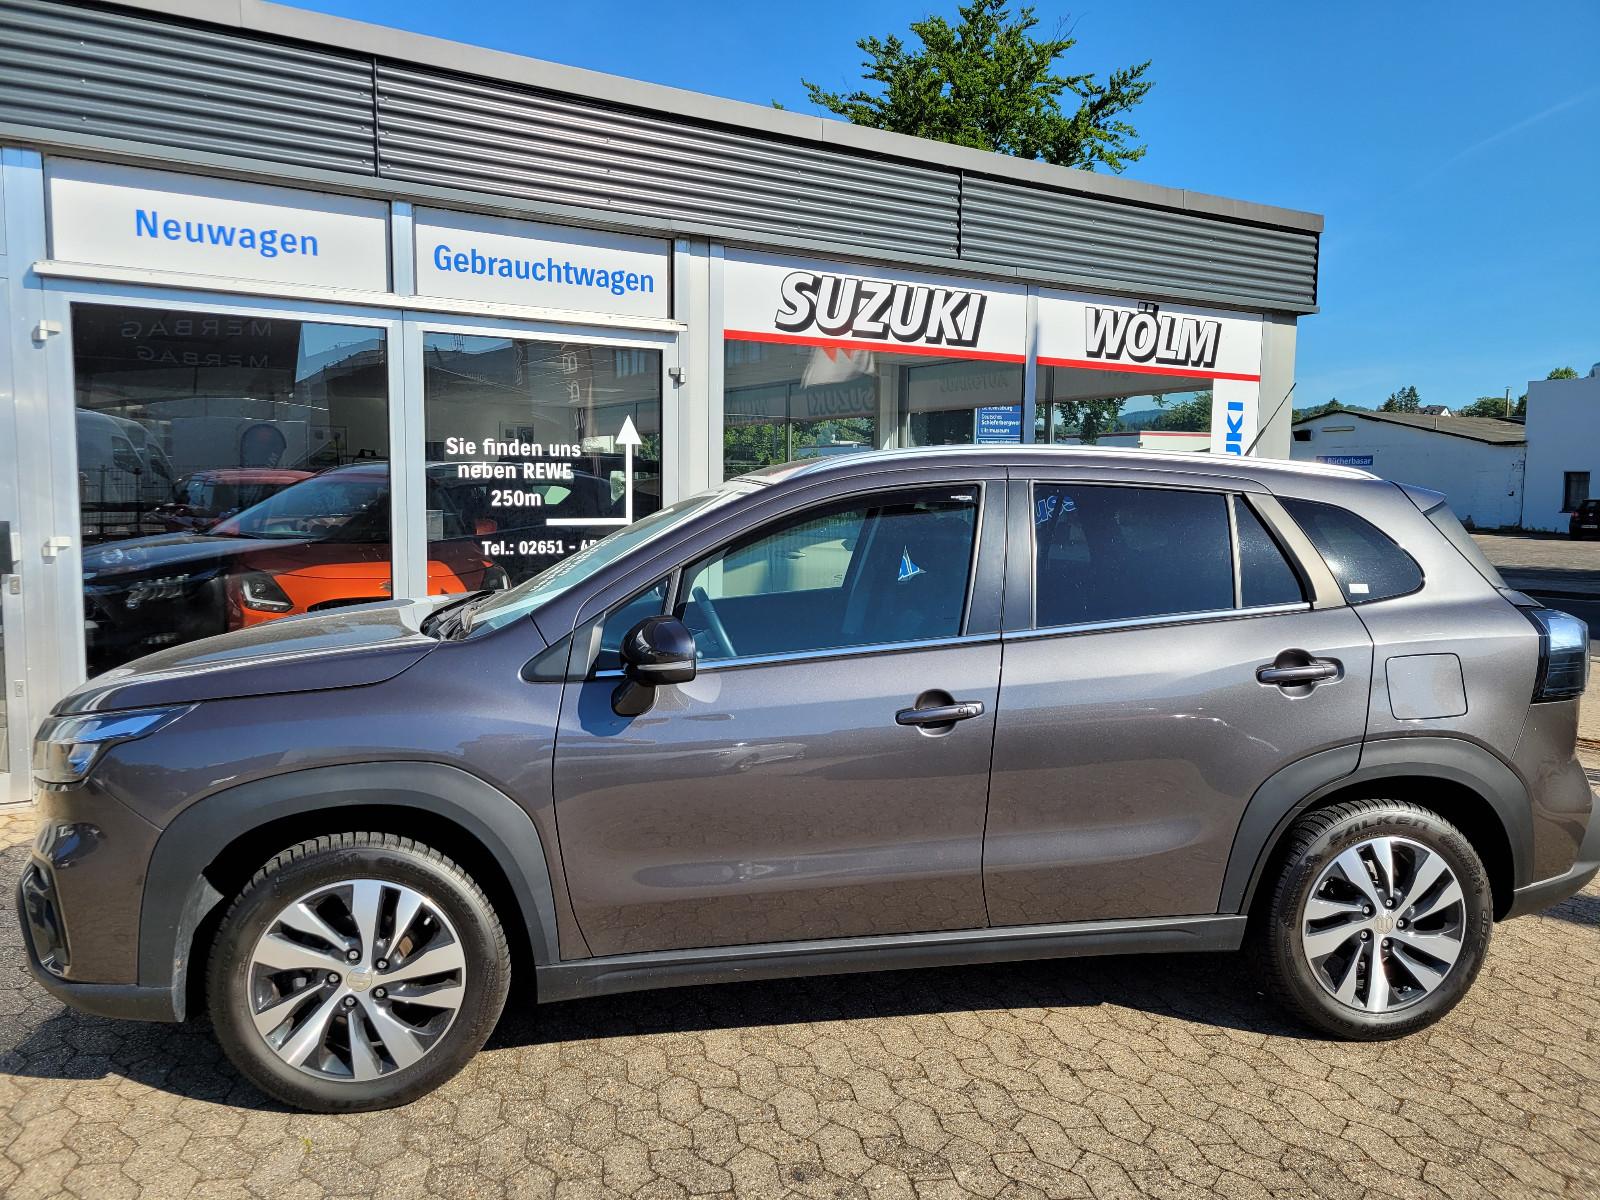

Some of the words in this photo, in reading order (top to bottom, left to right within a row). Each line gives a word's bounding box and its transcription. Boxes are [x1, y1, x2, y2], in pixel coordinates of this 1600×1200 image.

[135, 209, 319, 258] Neuwagen
[433, 244, 655, 296] Gebrauchtwagen
[775, 271, 987, 348] SUZUKI
[1085, 301, 1223, 368] WÖLM
[445, 437, 477, 455] Sie
[482, 438, 544, 457] finden
[549, 444, 582, 458] uns
[457, 462, 517, 479] neben
[523, 462, 573, 480] REWE
[1327, 456, 1372, 465] Bücherbasar
[490, 489, 542, 507] 250m
[481, 540, 515, 556] Tel.:
[518, 540, 565, 556] 02651
